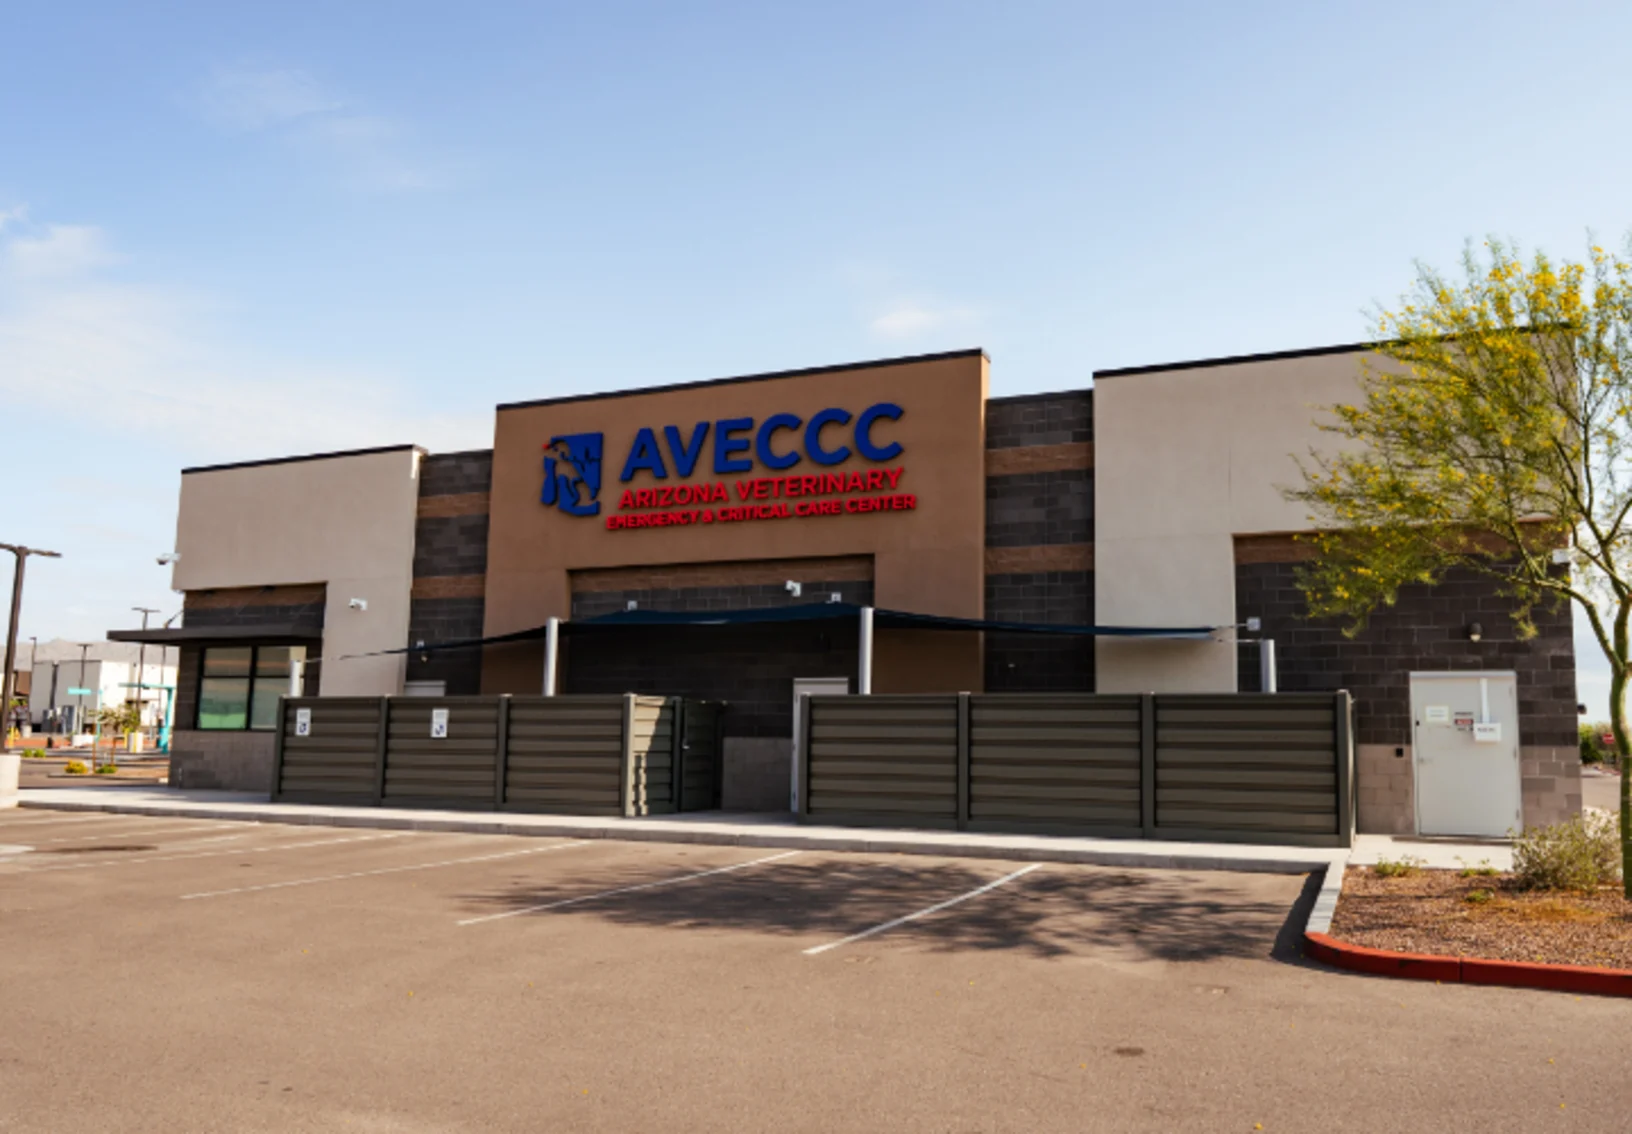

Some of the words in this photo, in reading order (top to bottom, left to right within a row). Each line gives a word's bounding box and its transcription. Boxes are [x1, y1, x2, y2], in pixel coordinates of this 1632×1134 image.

[620, 403, 904, 481] AVECCC
[618, 481, 729, 510] ARIZONA
[736, 467, 904, 500] VETERINARY
[606, 508, 700, 530] EMERGENCY
[702, 508, 713, 523] &
[717, 503, 791, 521] CRITICAL
[795, 499, 841, 516] CARE
[845, 494, 917, 513] CENTER
